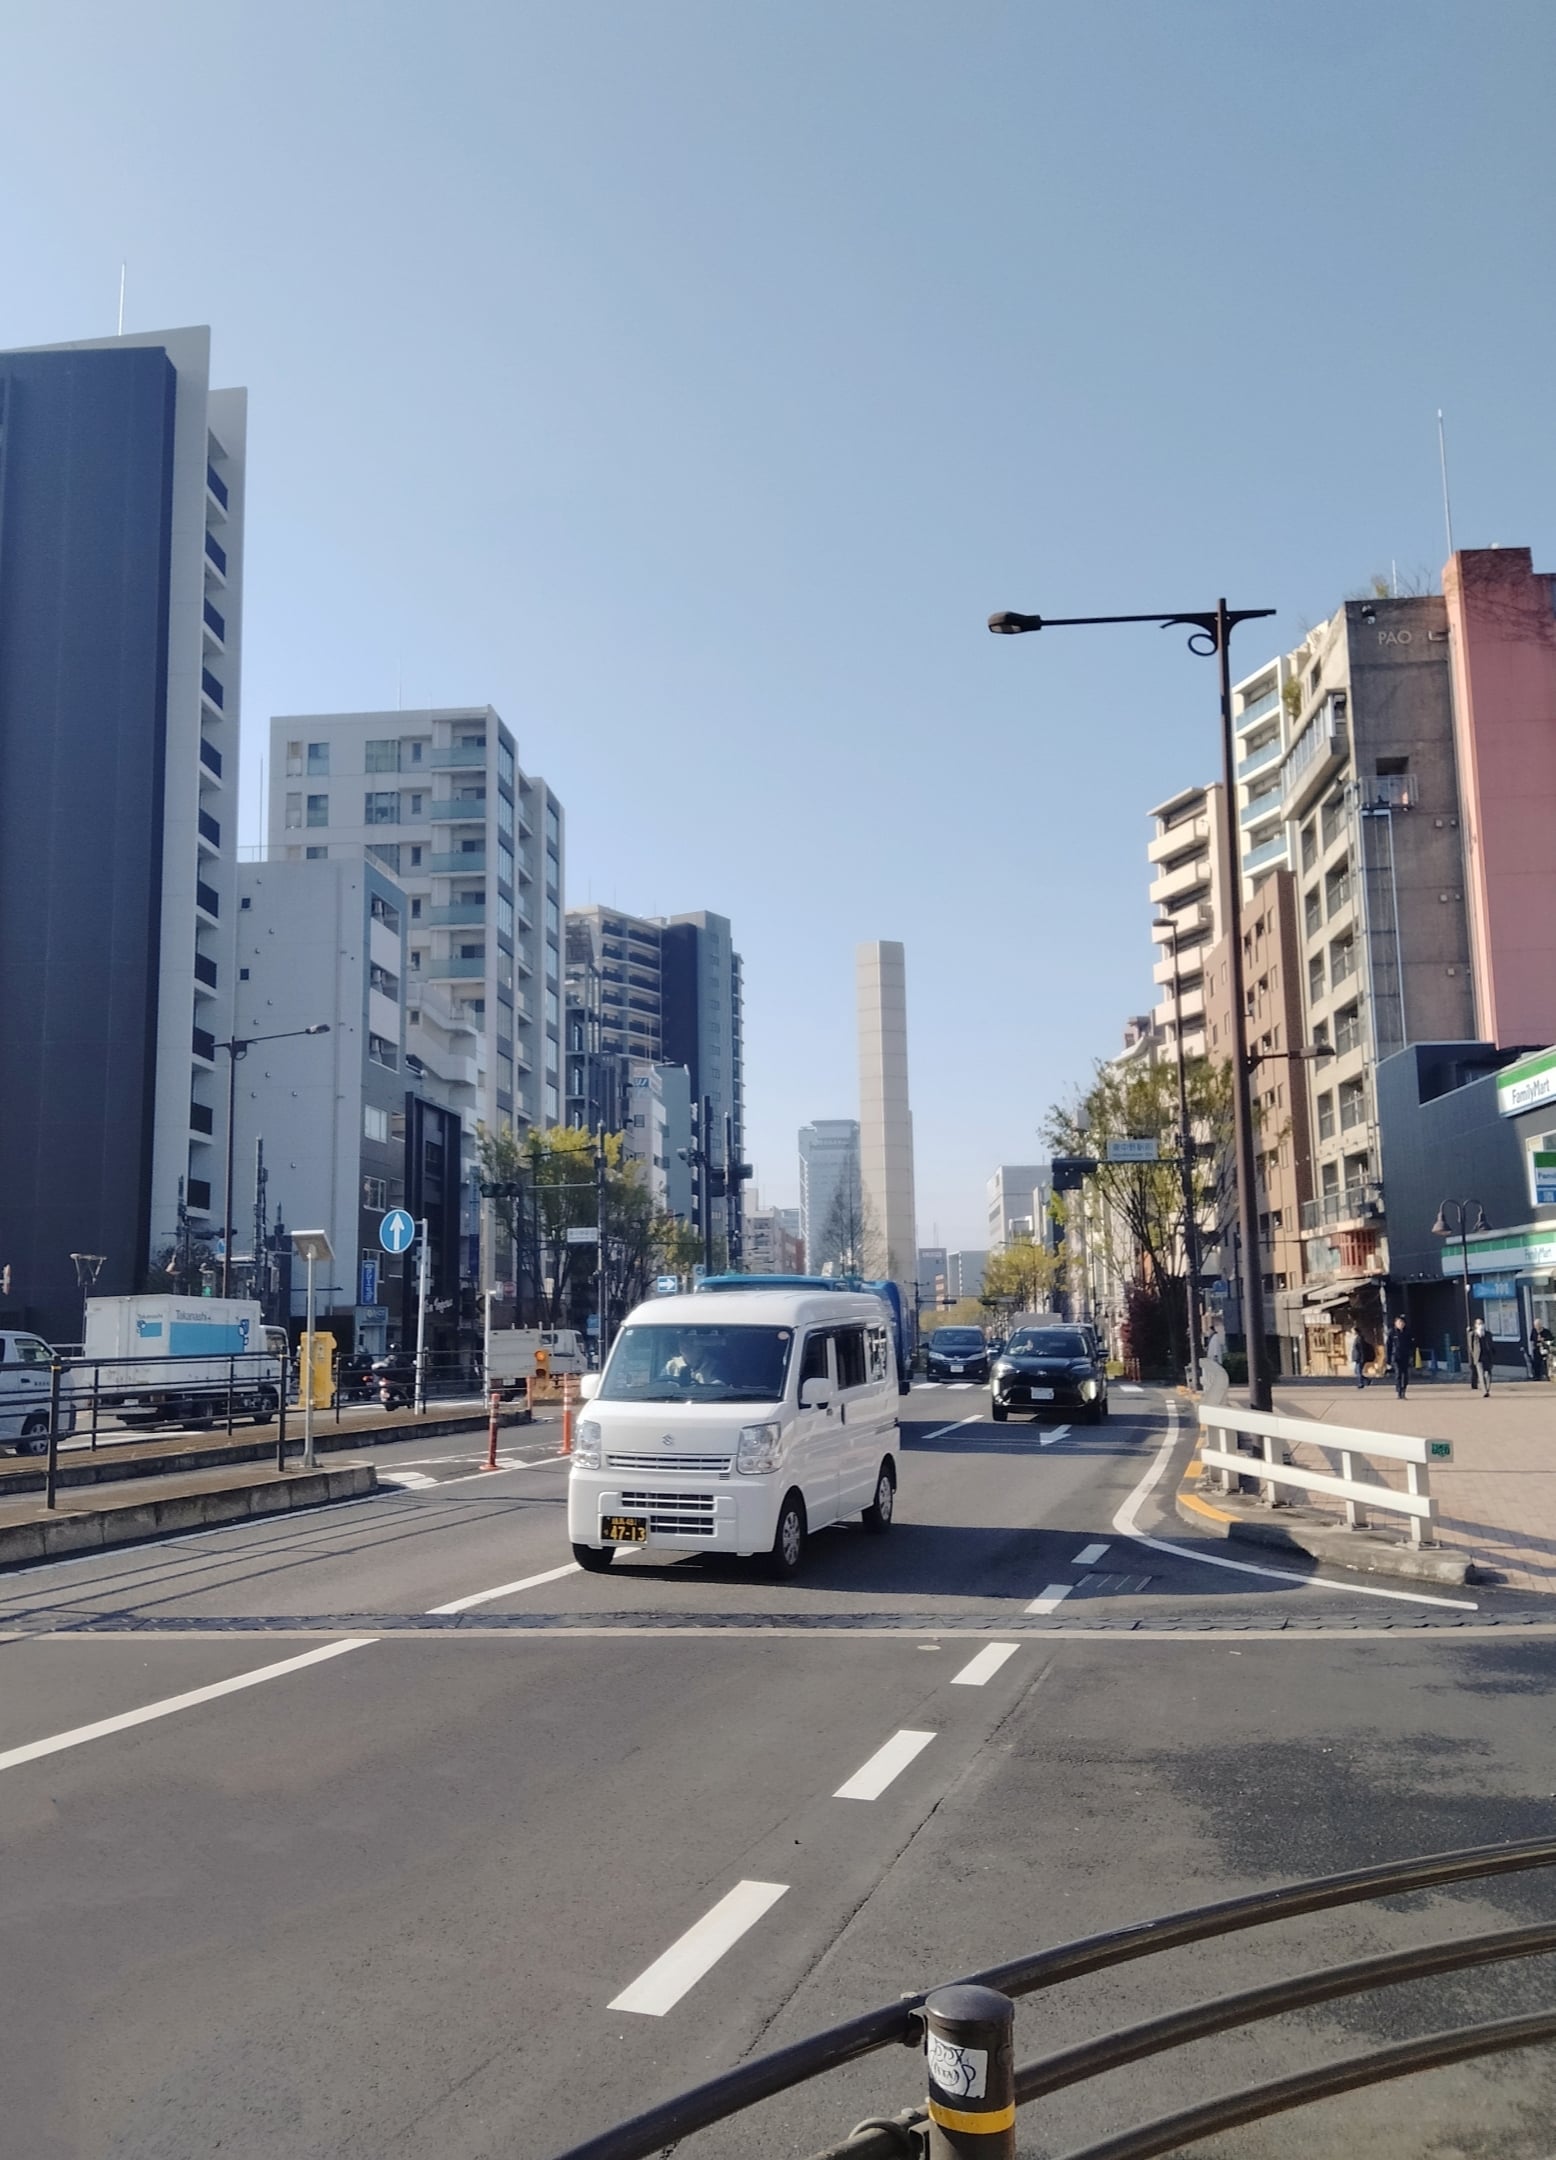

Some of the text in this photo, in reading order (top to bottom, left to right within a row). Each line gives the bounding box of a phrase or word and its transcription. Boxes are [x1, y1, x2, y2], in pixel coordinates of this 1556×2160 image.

[1378, 630, 1412, 645] PAO
[1512, 1078, 1550, 1105] FamilyMart
[176, 1309, 207, 1320] Takanashi
[610, 1525, 646, 1541] 47-13
